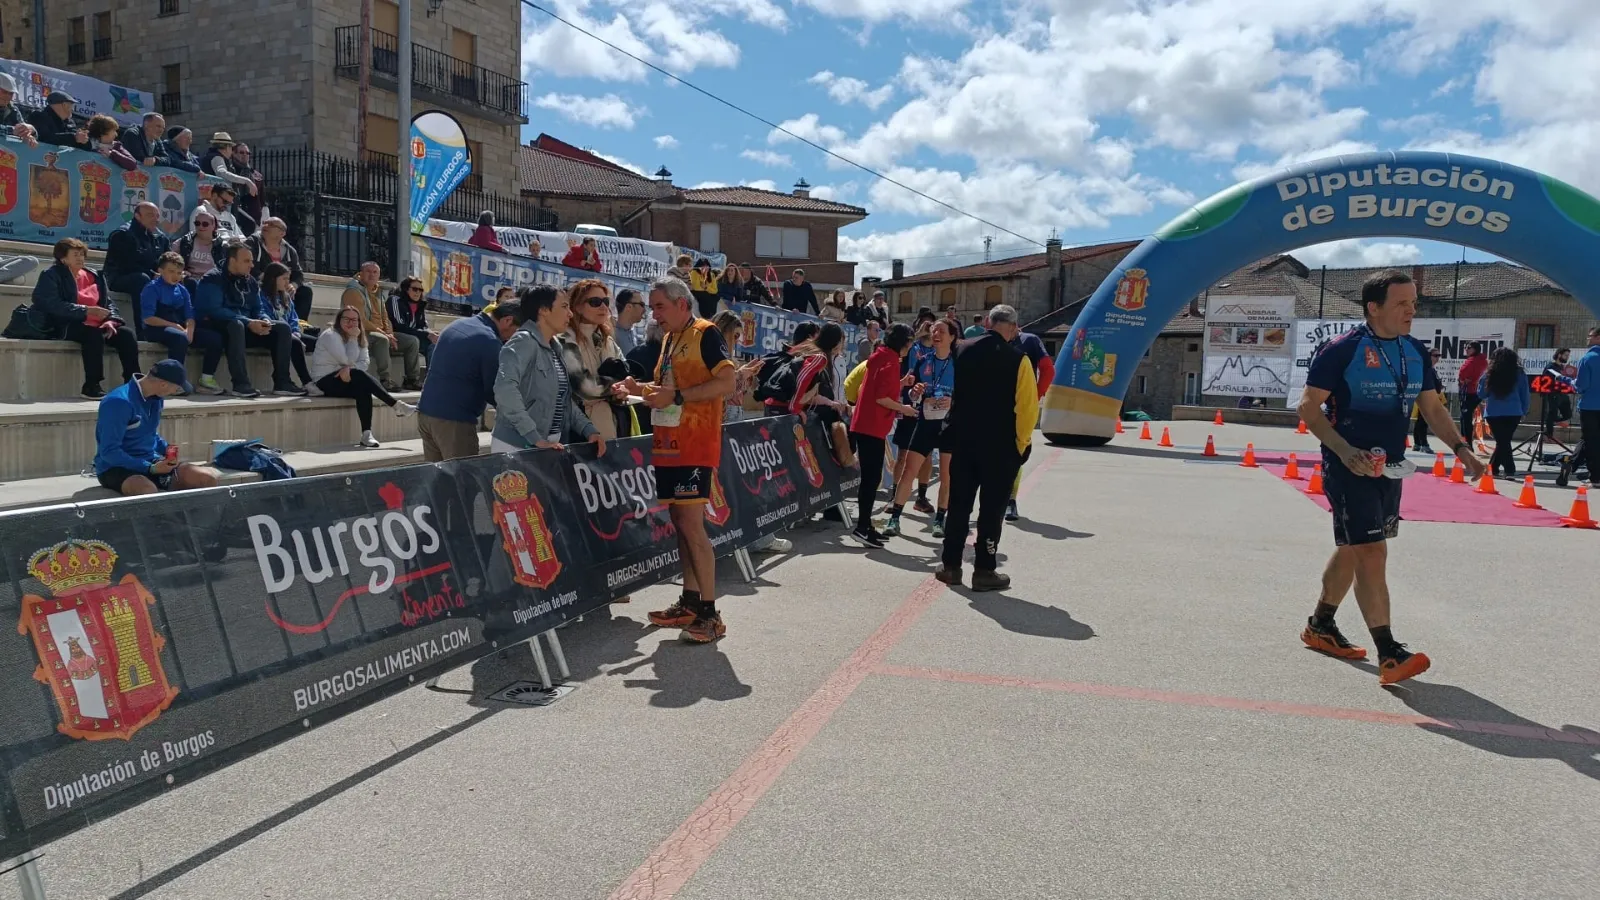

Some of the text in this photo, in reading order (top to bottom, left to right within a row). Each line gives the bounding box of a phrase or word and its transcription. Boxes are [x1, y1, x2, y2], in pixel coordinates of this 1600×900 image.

[436, 150, 464, 192] BURGOS
[1276, 164, 1515, 201] Diputación
[1282, 194, 1511, 233] de Burgos
[1105, 311, 1147, 322] Diputación
[1117, 319, 1145, 327] Burgos
[729, 437, 783, 480] Burgos
[573, 463, 657, 519] Burgos
[247, 505, 440, 594] Burgos
[607, 548, 680, 587] BURGOSALIMENTA.CO
[513, 590, 578, 626] Diputación de Burgos
[293, 626, 471, 711] BURGOSALIMENTA.COM
[44, 730, 216, 810] Diputación de Burgos
